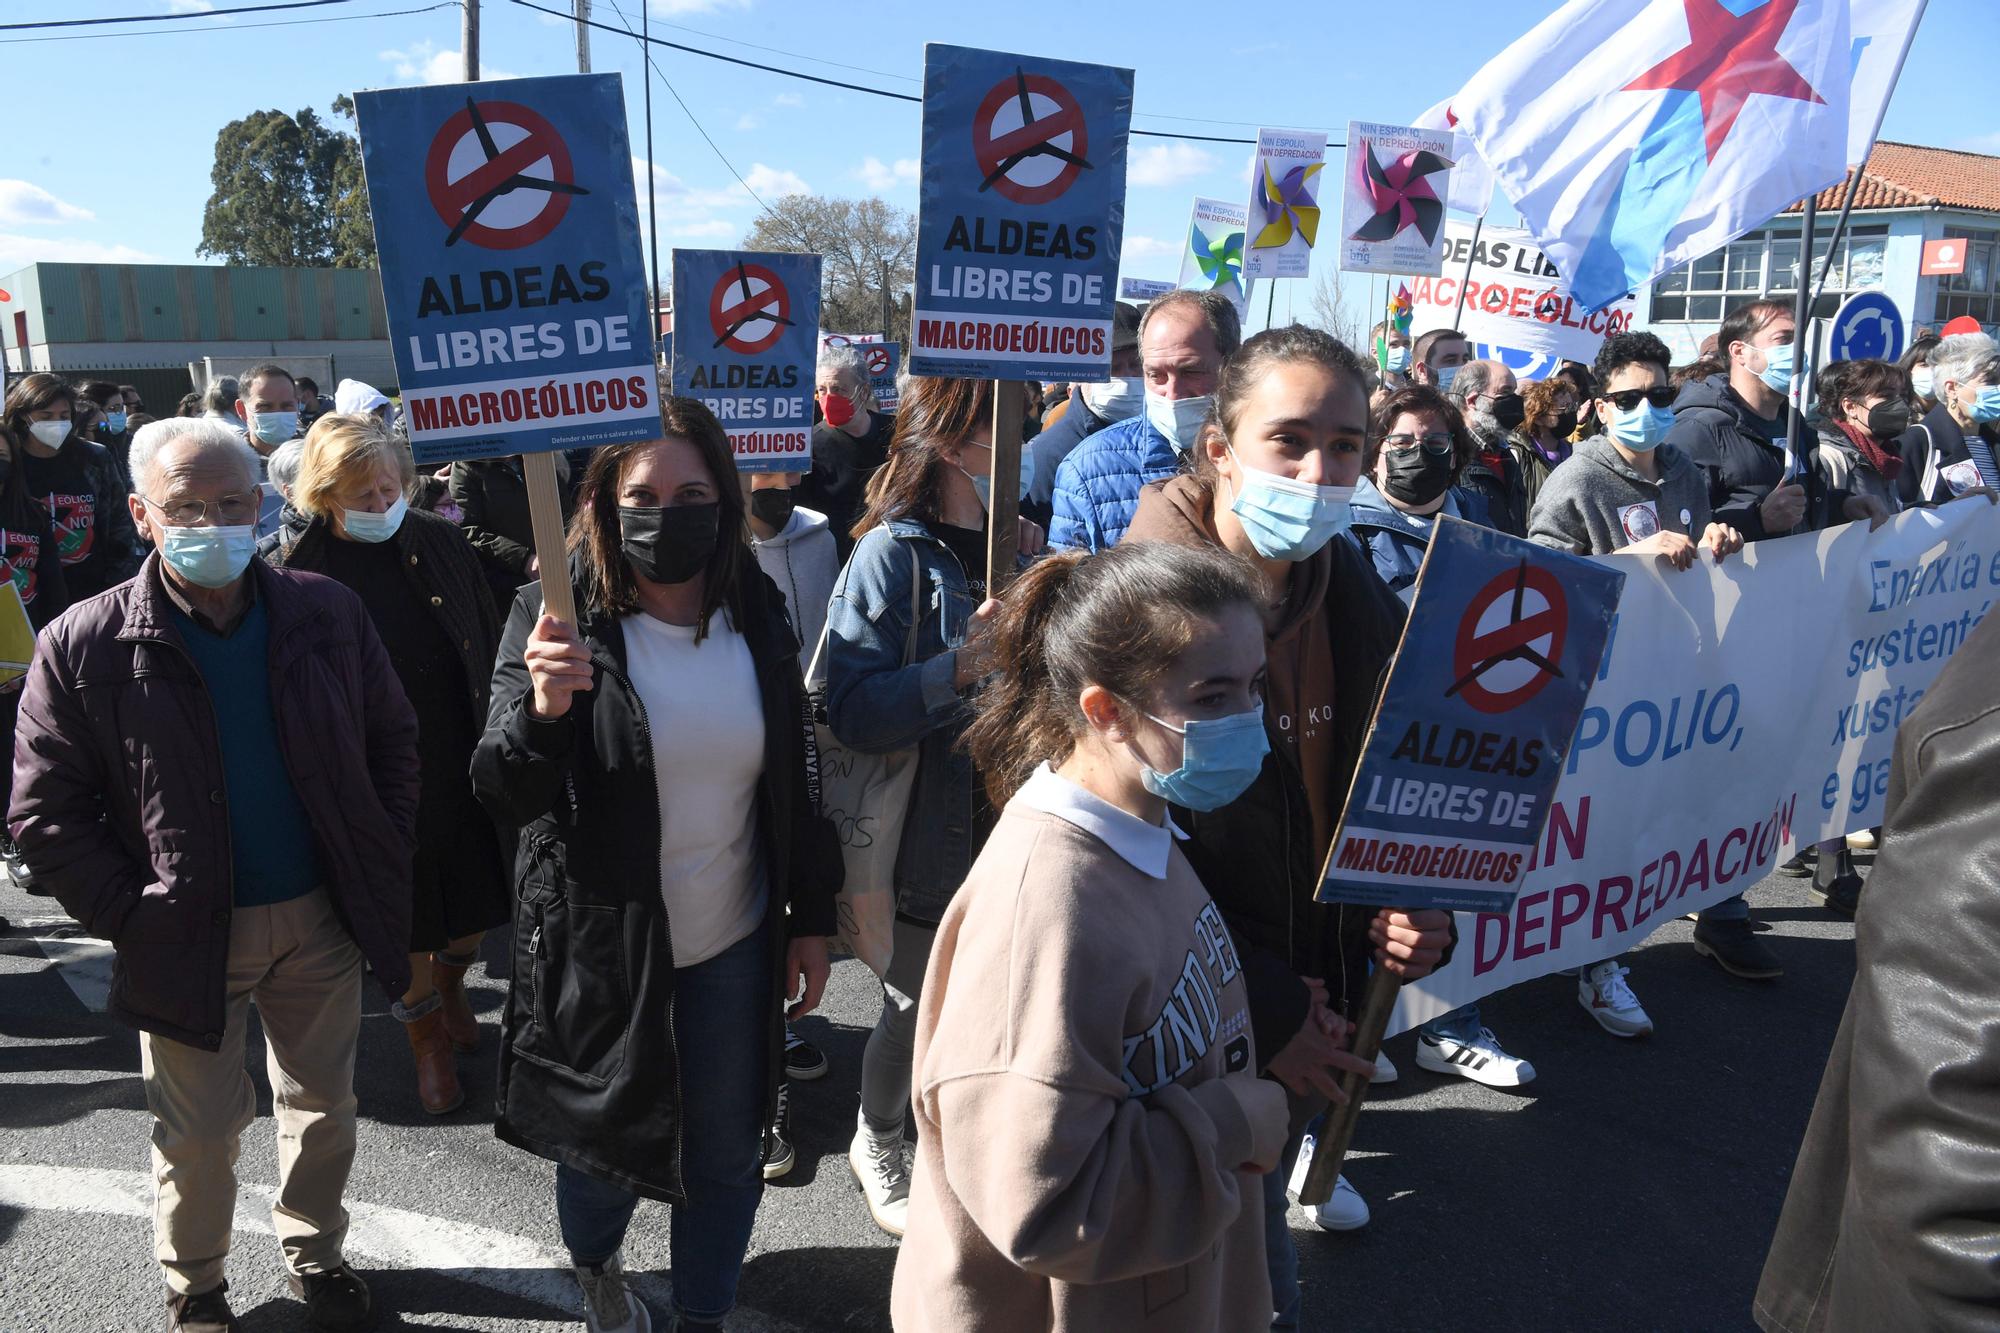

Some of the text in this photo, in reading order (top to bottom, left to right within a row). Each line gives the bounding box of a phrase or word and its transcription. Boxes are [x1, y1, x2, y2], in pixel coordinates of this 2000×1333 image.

[1261, 137, 1275, 147] NIN
[1360, 124, 1377, 134] NIN
[1379, 137, 1445, 152] DEPREDACIÓN
[1260, 149, 1322, 160] NIN DEPREDACIÓN
[1196, 212, 1211, 221] NIN
[1198, 203, 1212, 213] NIN
[943, 215, 1097, 260] ALDEAS
[417, 261, 611, 319] ALDEAS
[931, 264, 1052, 303] LIBRES
[1062, 274, 1103, 306] DE
[409, 314, 632, 372] LIBRES DE
[918, 319, 1106, 356] MACROEÓLICOS
[689, 365, 798, 389] ALDEAS
[411, 375, 648, 432] MACROEÓLICOS
[773, 397, 803, 419] DE
[1390, 720, 1544, 778] ALDEAS
[1566, 683, 1745, 776] POLIO,
[1365, 775, 1537, 828] LIBRES DE
[1336, 837, 1523, 884] MACROEÓLICOS
[1472, 791, 1798, 978] DEPREDACIÓN
